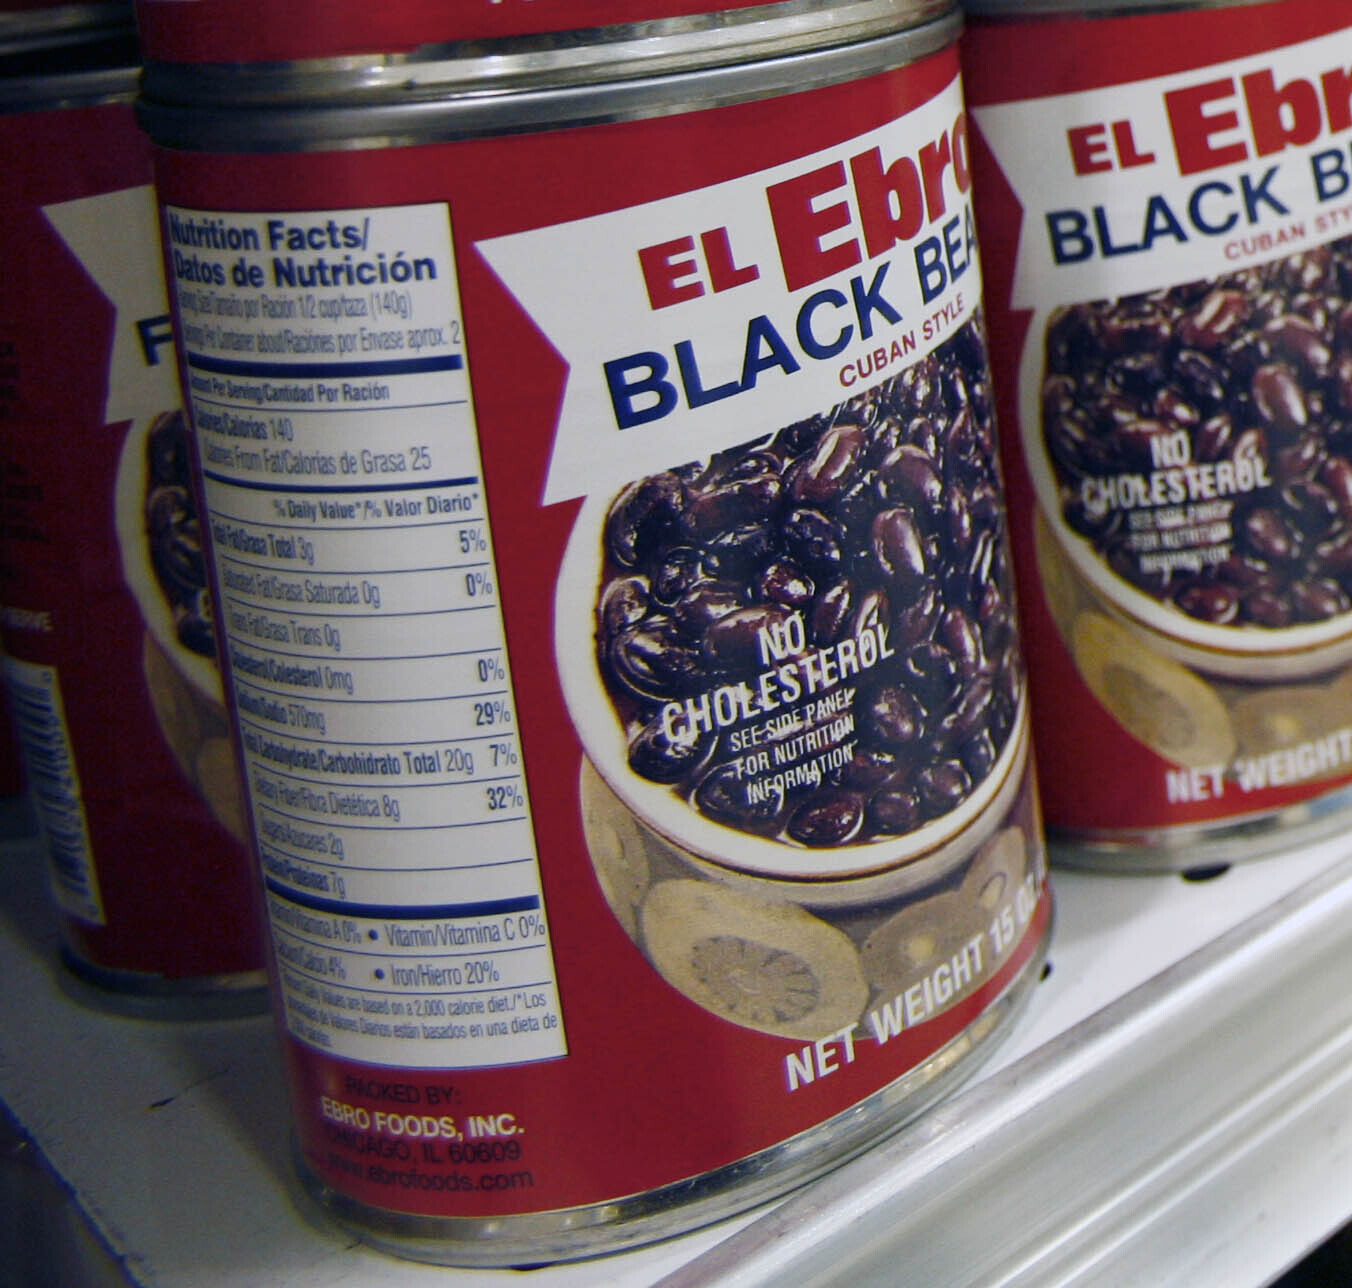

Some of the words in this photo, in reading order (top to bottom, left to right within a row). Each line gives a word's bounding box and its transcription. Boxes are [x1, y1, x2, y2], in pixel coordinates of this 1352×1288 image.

[1066, 119, 1155, 177] EL
[637, 226, 761, 311] EL
[766, 112, 971, 293] Ebro
[1045, 164, 1292, 266] BLACK
[170, 213, 259, 251] Nutrition
[267, 217, 370, 251] Facts/
[1223, 226, 1306, 262] CUBAN
[174, 248, 227, 286] Datos
[232, 259, 265, 288] de
[274, 250, 438, 288] Nutrición
[452, 319, 462, 346] 2
[603, 261, 903, 430] BLACK
[838, 329, 917, 388] CUBAN
[922, 291, 966, 341] STYLE
[341, 380, 391, 403] Ración
[339, 451, 358, 475] de
[359, 449, 408, 475] Grasa
[409, 445, 432, 471] 25
[1151, 429, 1193, 469] NO
[1080, 455, 1272, 510] CHOLESTEROL
[383, 498, 423, 518] Valor
[458, 528, 487, 554] 5%
[464, 572, 493, 597] 0%
[758, 611, 806, 665] NO
[477, 657, 505, 684] 0%
[660, 623, 895, 745] CHOLESTEROL
[474, 700, 511, 727] 29%
[730, 723, 762, 753] SEE
[806, 688, 855, 726] PANEL
[402, 749, 442, 776] Total
[445, 747, 475, 776] 20g
[489, 742, 518, 768] 7%
[733, 752, 770, 781] FOR
[773, 714, 856, 766] NUTRITION
[747, 744, 856, 805] INFORMATION
[1165, 767, 1226, 804] NET
[382, 794, 401, 823] 8g
[486, 785, 524, 811] 32%
[502, 915, 516, 941] C
[518, 913, 546, 939] 0%
[464, 960, 500, 985] 20%
[784, 1021, 860, 1082] NET
[870, 932, 985, 1046] WEIGHT
[989, 905, 1015, 954] 15
[320, 1095, 371, 1130] EBRO
[374, 1111, 465, 1142] FOODS,
[467, 1113, 525, 1138] INC.
[448, 1140, 522, 1164] 60609
